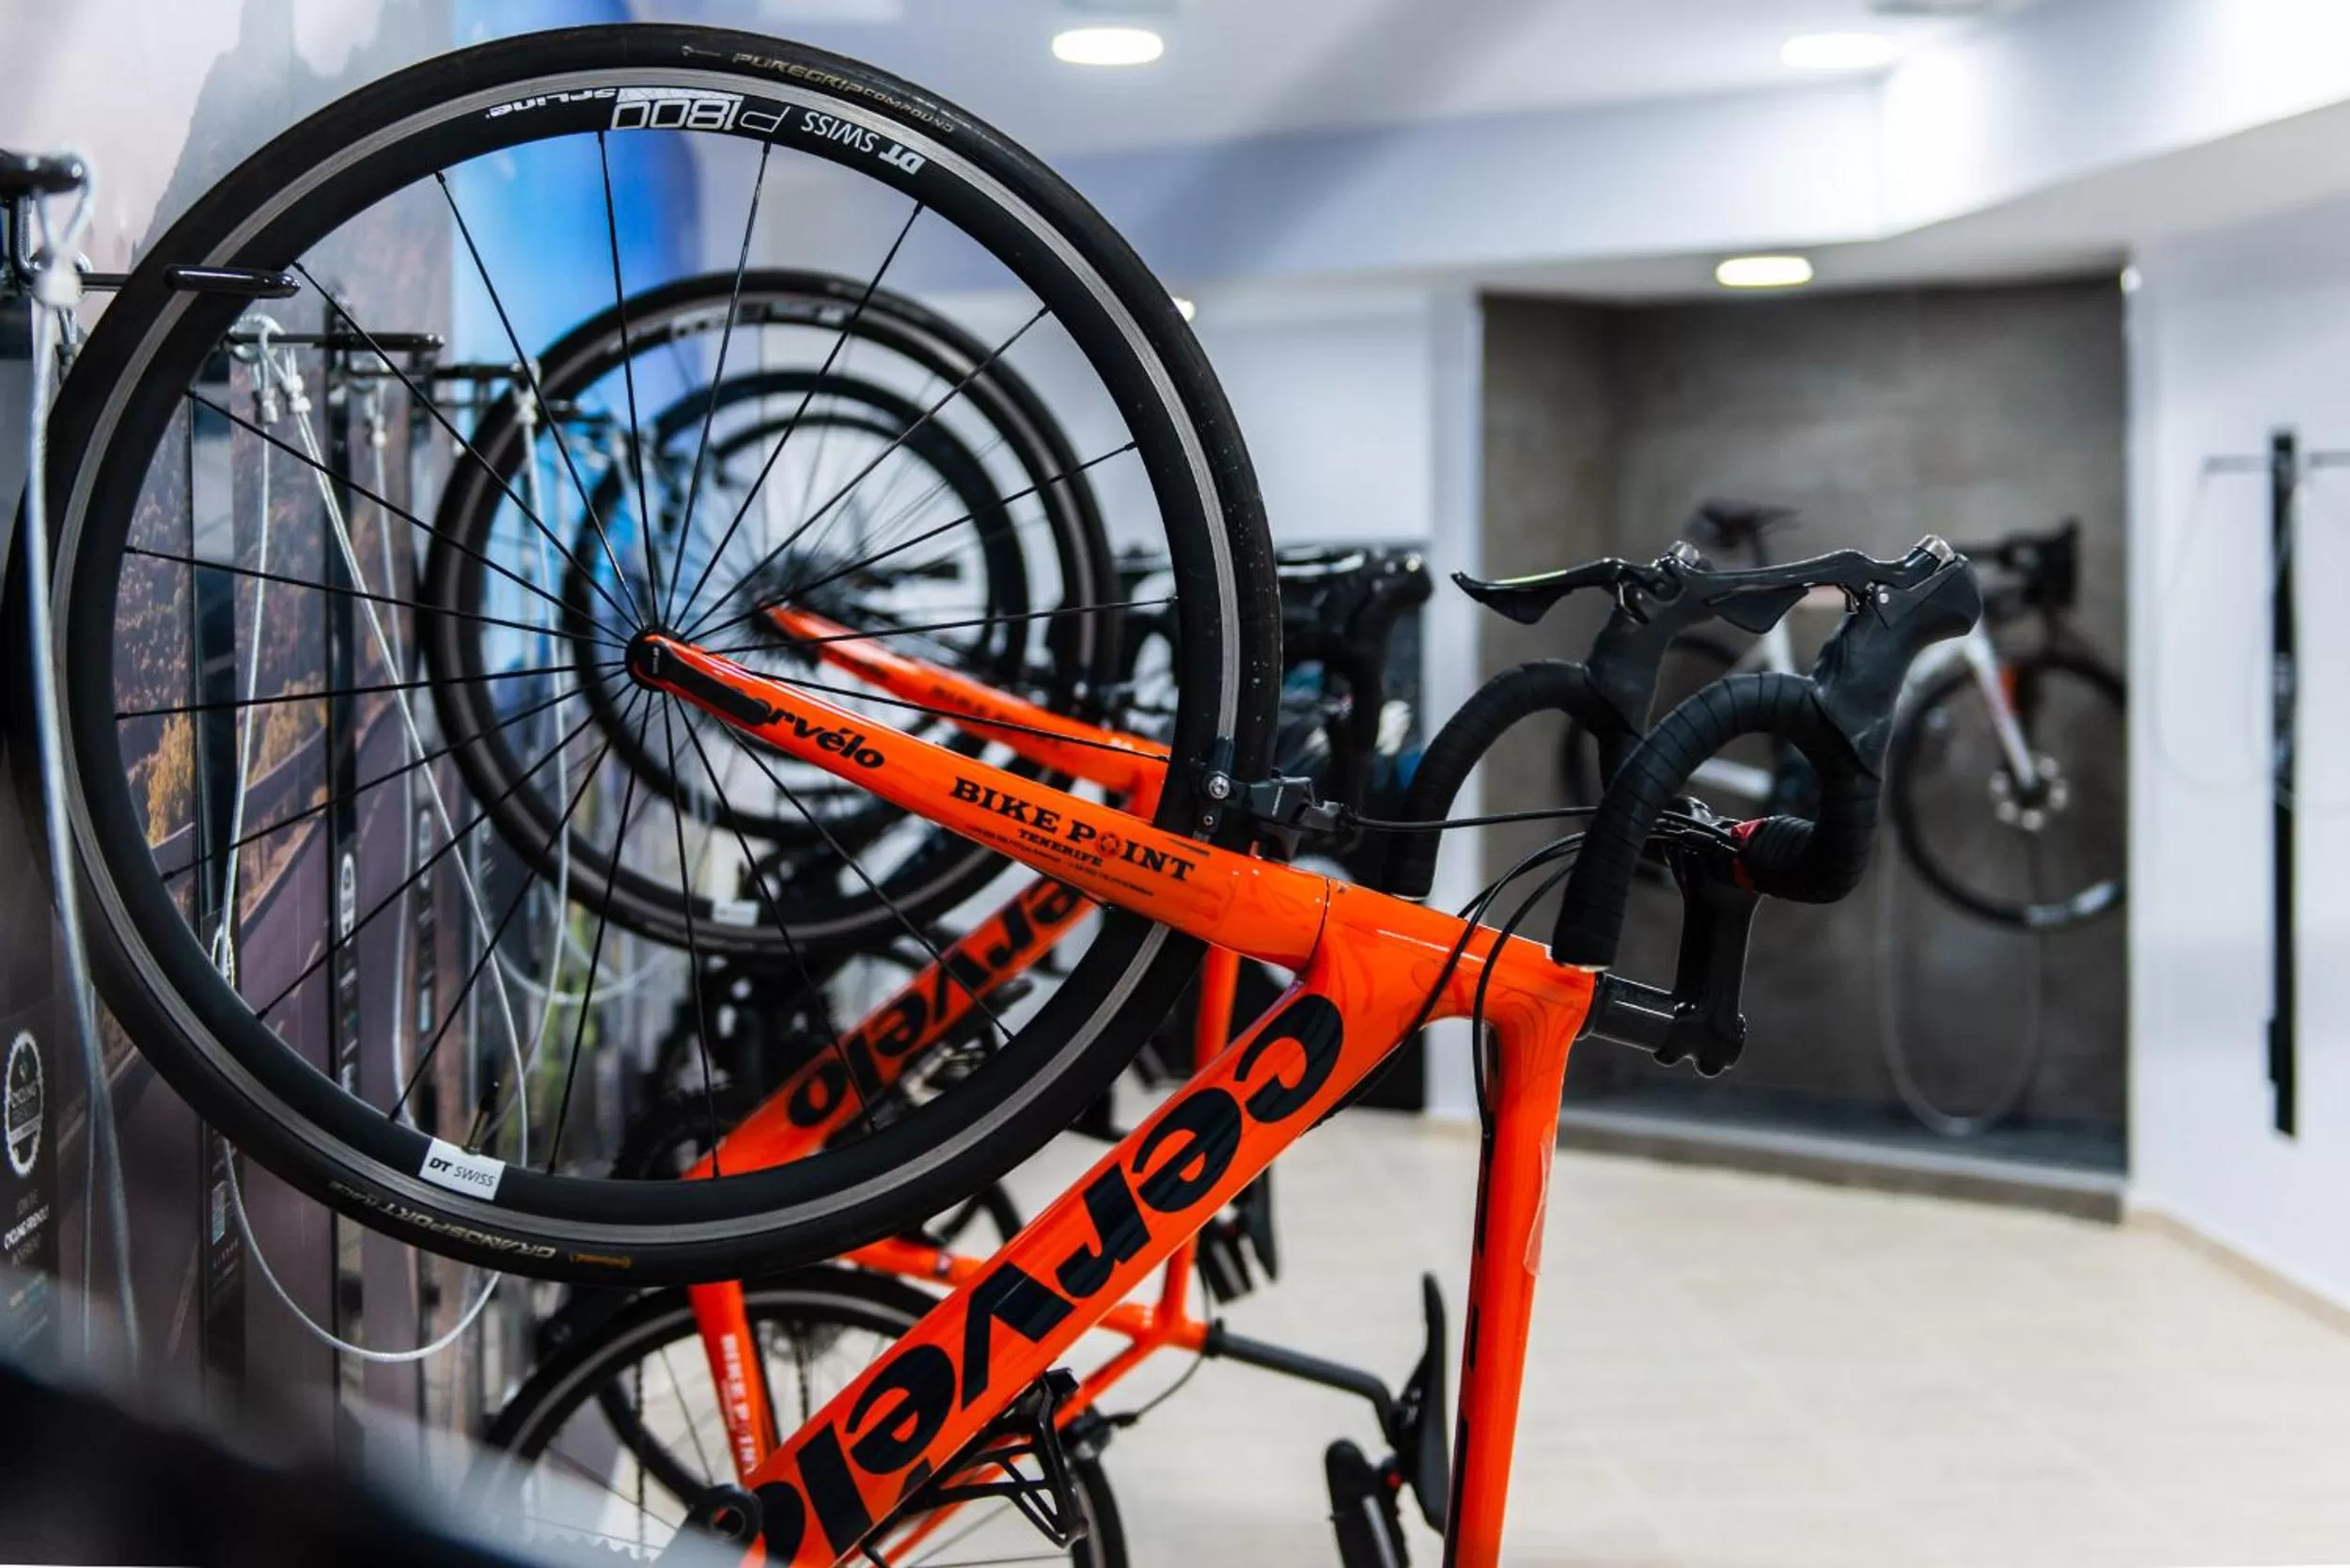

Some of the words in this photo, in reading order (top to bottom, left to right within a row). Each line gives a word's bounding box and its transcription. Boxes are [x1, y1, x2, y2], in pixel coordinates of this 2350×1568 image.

[800, 110, 881, 153] SWISS
[877, 143, 927, 176] DT
[750, 698, 885, 769] rvélo
[948, 776, 1061, 835] BIKE
[1064, 819, 1196, 882] POINT
[1017, 827, 1104, 868] TENERIFE
[786, 879, 1085, 1128] ervélo
[428, 1156, 453, 1173] DT
[453, 1164, 496, 1188] SWISS
[378, 1200, 557, 1260] GRANDSPORT
